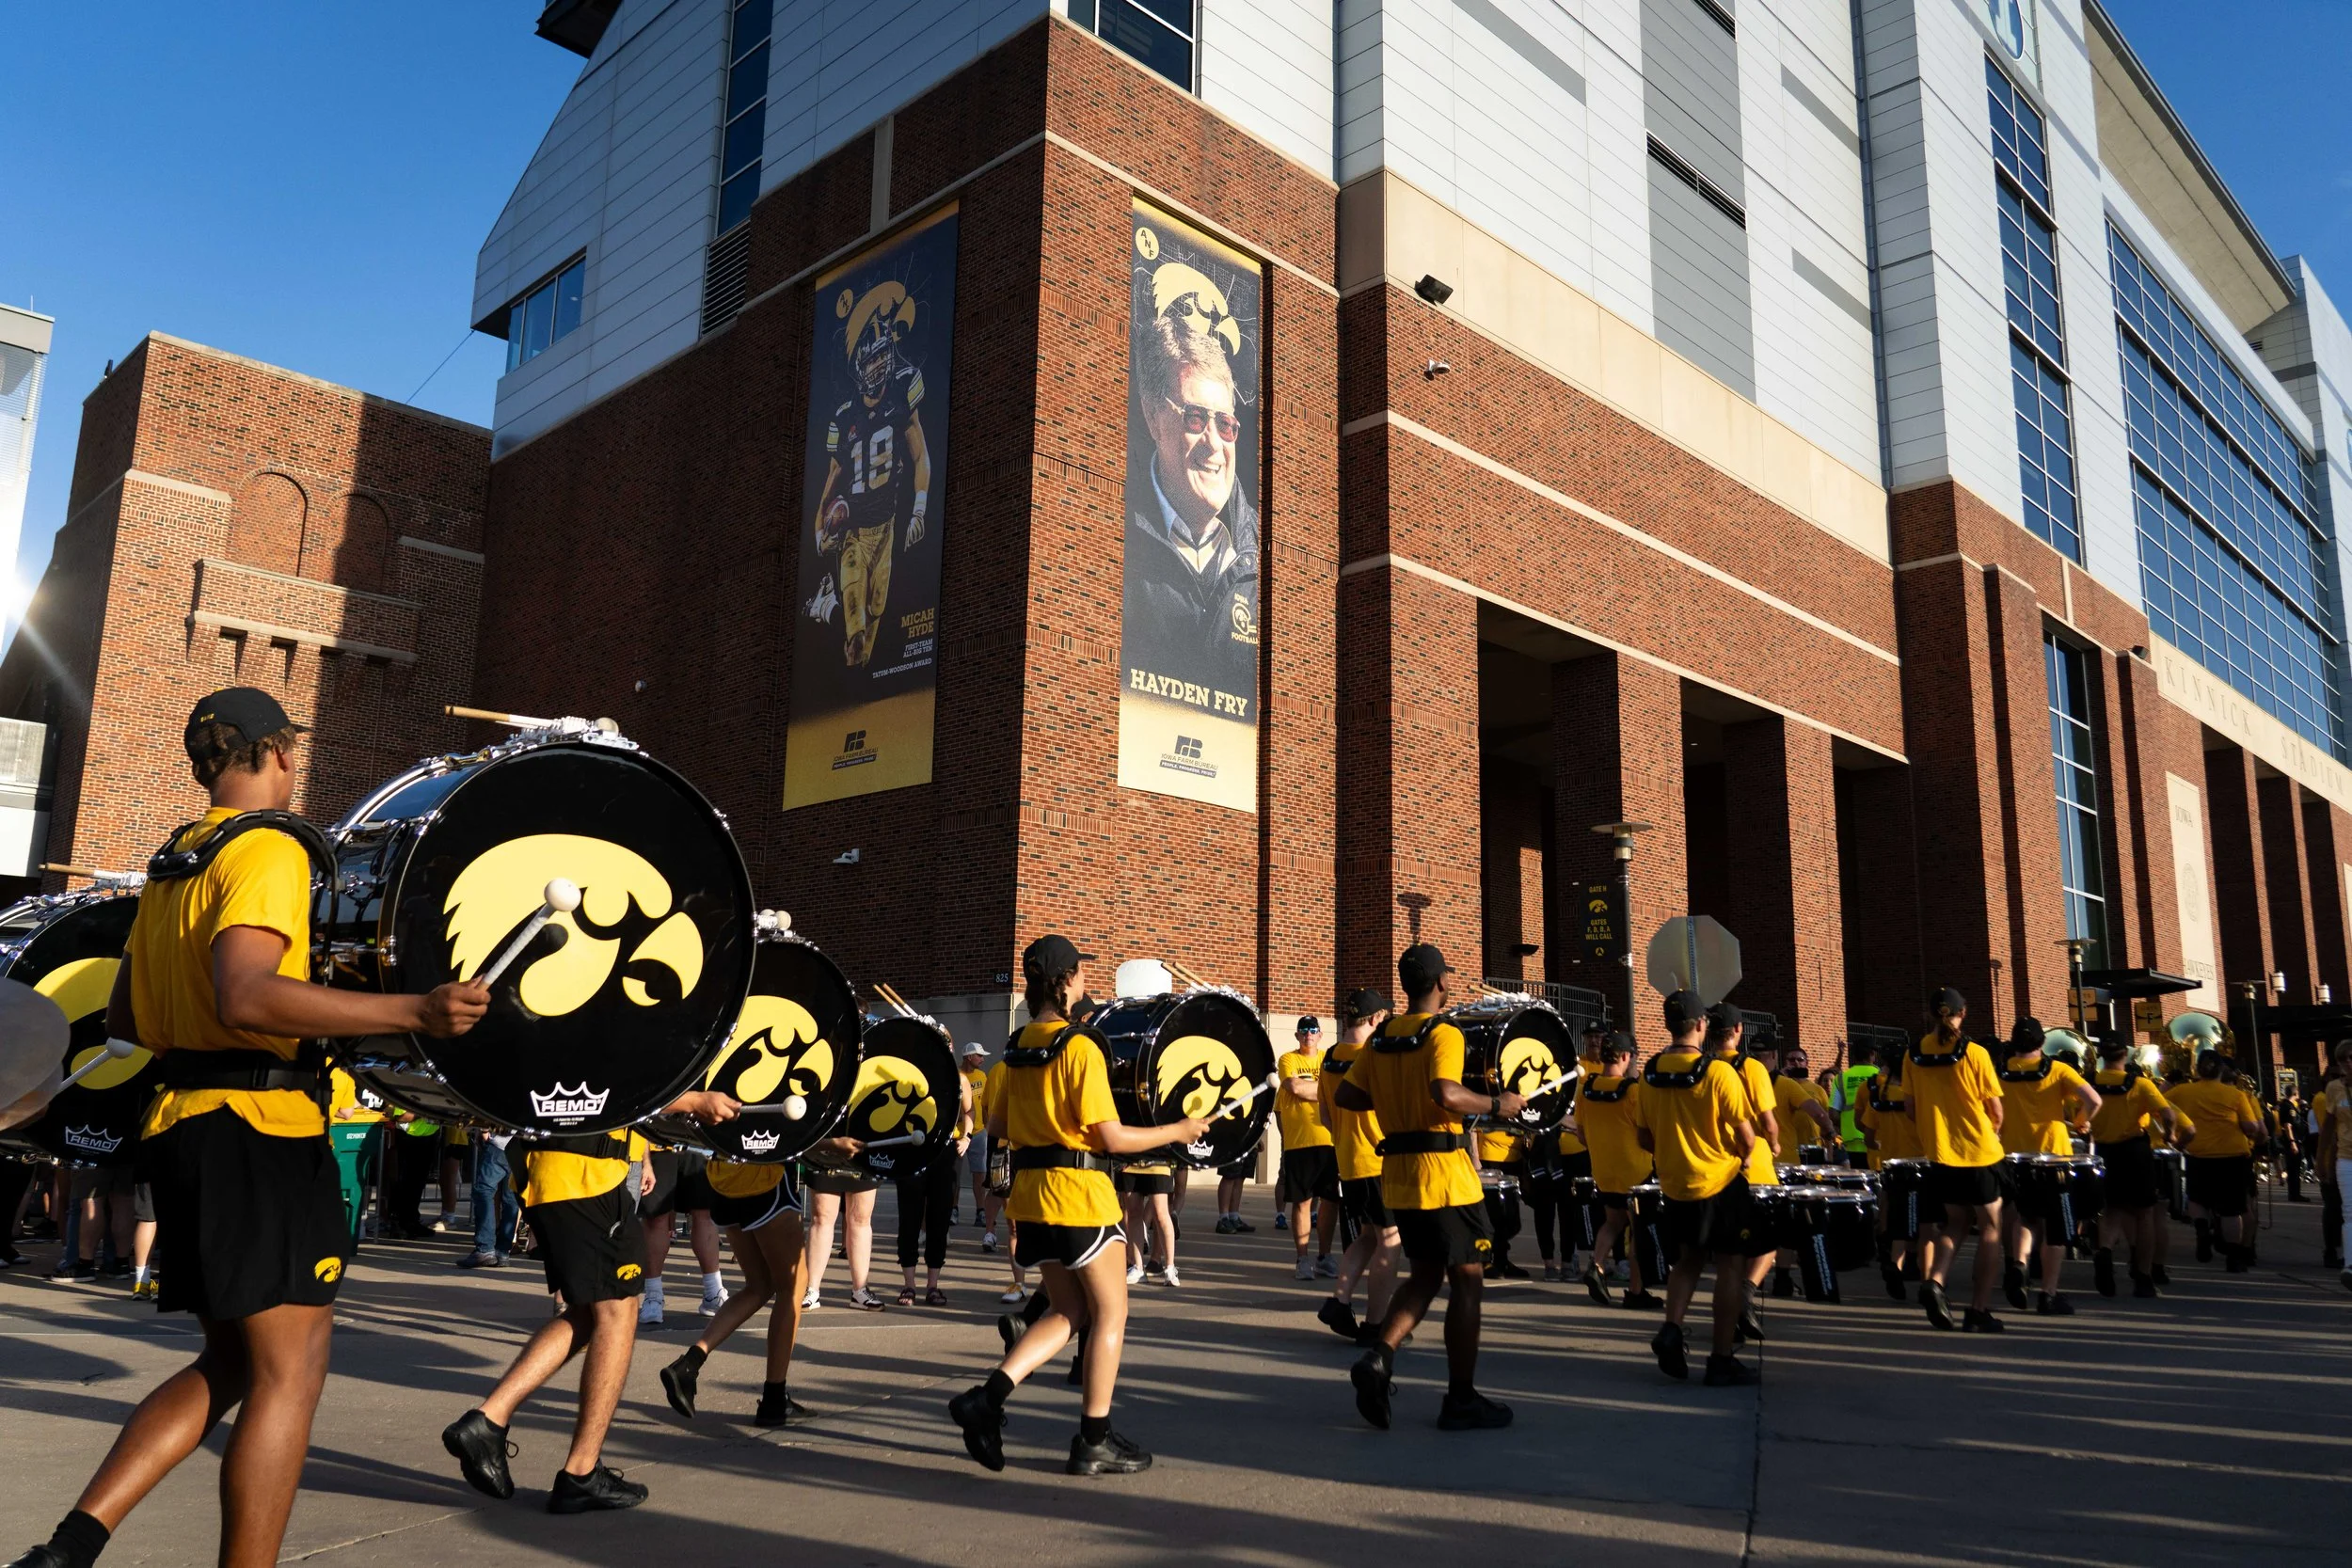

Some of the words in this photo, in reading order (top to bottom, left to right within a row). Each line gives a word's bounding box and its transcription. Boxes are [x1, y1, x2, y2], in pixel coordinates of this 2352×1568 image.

[850, 425, 893, 495] 18
[900, 608, 934, 628] MICAH
[908, 621, 934, 639] HYDE
[903, 647, 922, 658] ALL-BIG
[923, 645, 933, 654] TEN
[904, 639, 933, 652] FIRST-TEAM
[872, 661, 914, 679] TATUM-WOODSON
[914, 657, 932, 668] AWARD
[1130, 669, 1210, 707] HAYDEN
[1214, 690, 1248, 716] FRY
[2164, 656, 2251, 736] KINNICK
[2281, 736, 2344, 796] STADIUM
[1161, 753, 1176, 762] IOWA
[1177, 756, 1194, 766] FARM
[1194, 760, 1218, 770] BUREAU
[2175, 805, 2194, 828] IOWA
[995, 973, 1008, 983] 825
[2147, 1012, 2153, 1024] F
[541, 1100, 598, 1112] REMO
[71, 1134, 112, 1149] REMO
[746, 1139, 774, 1148] REMO
